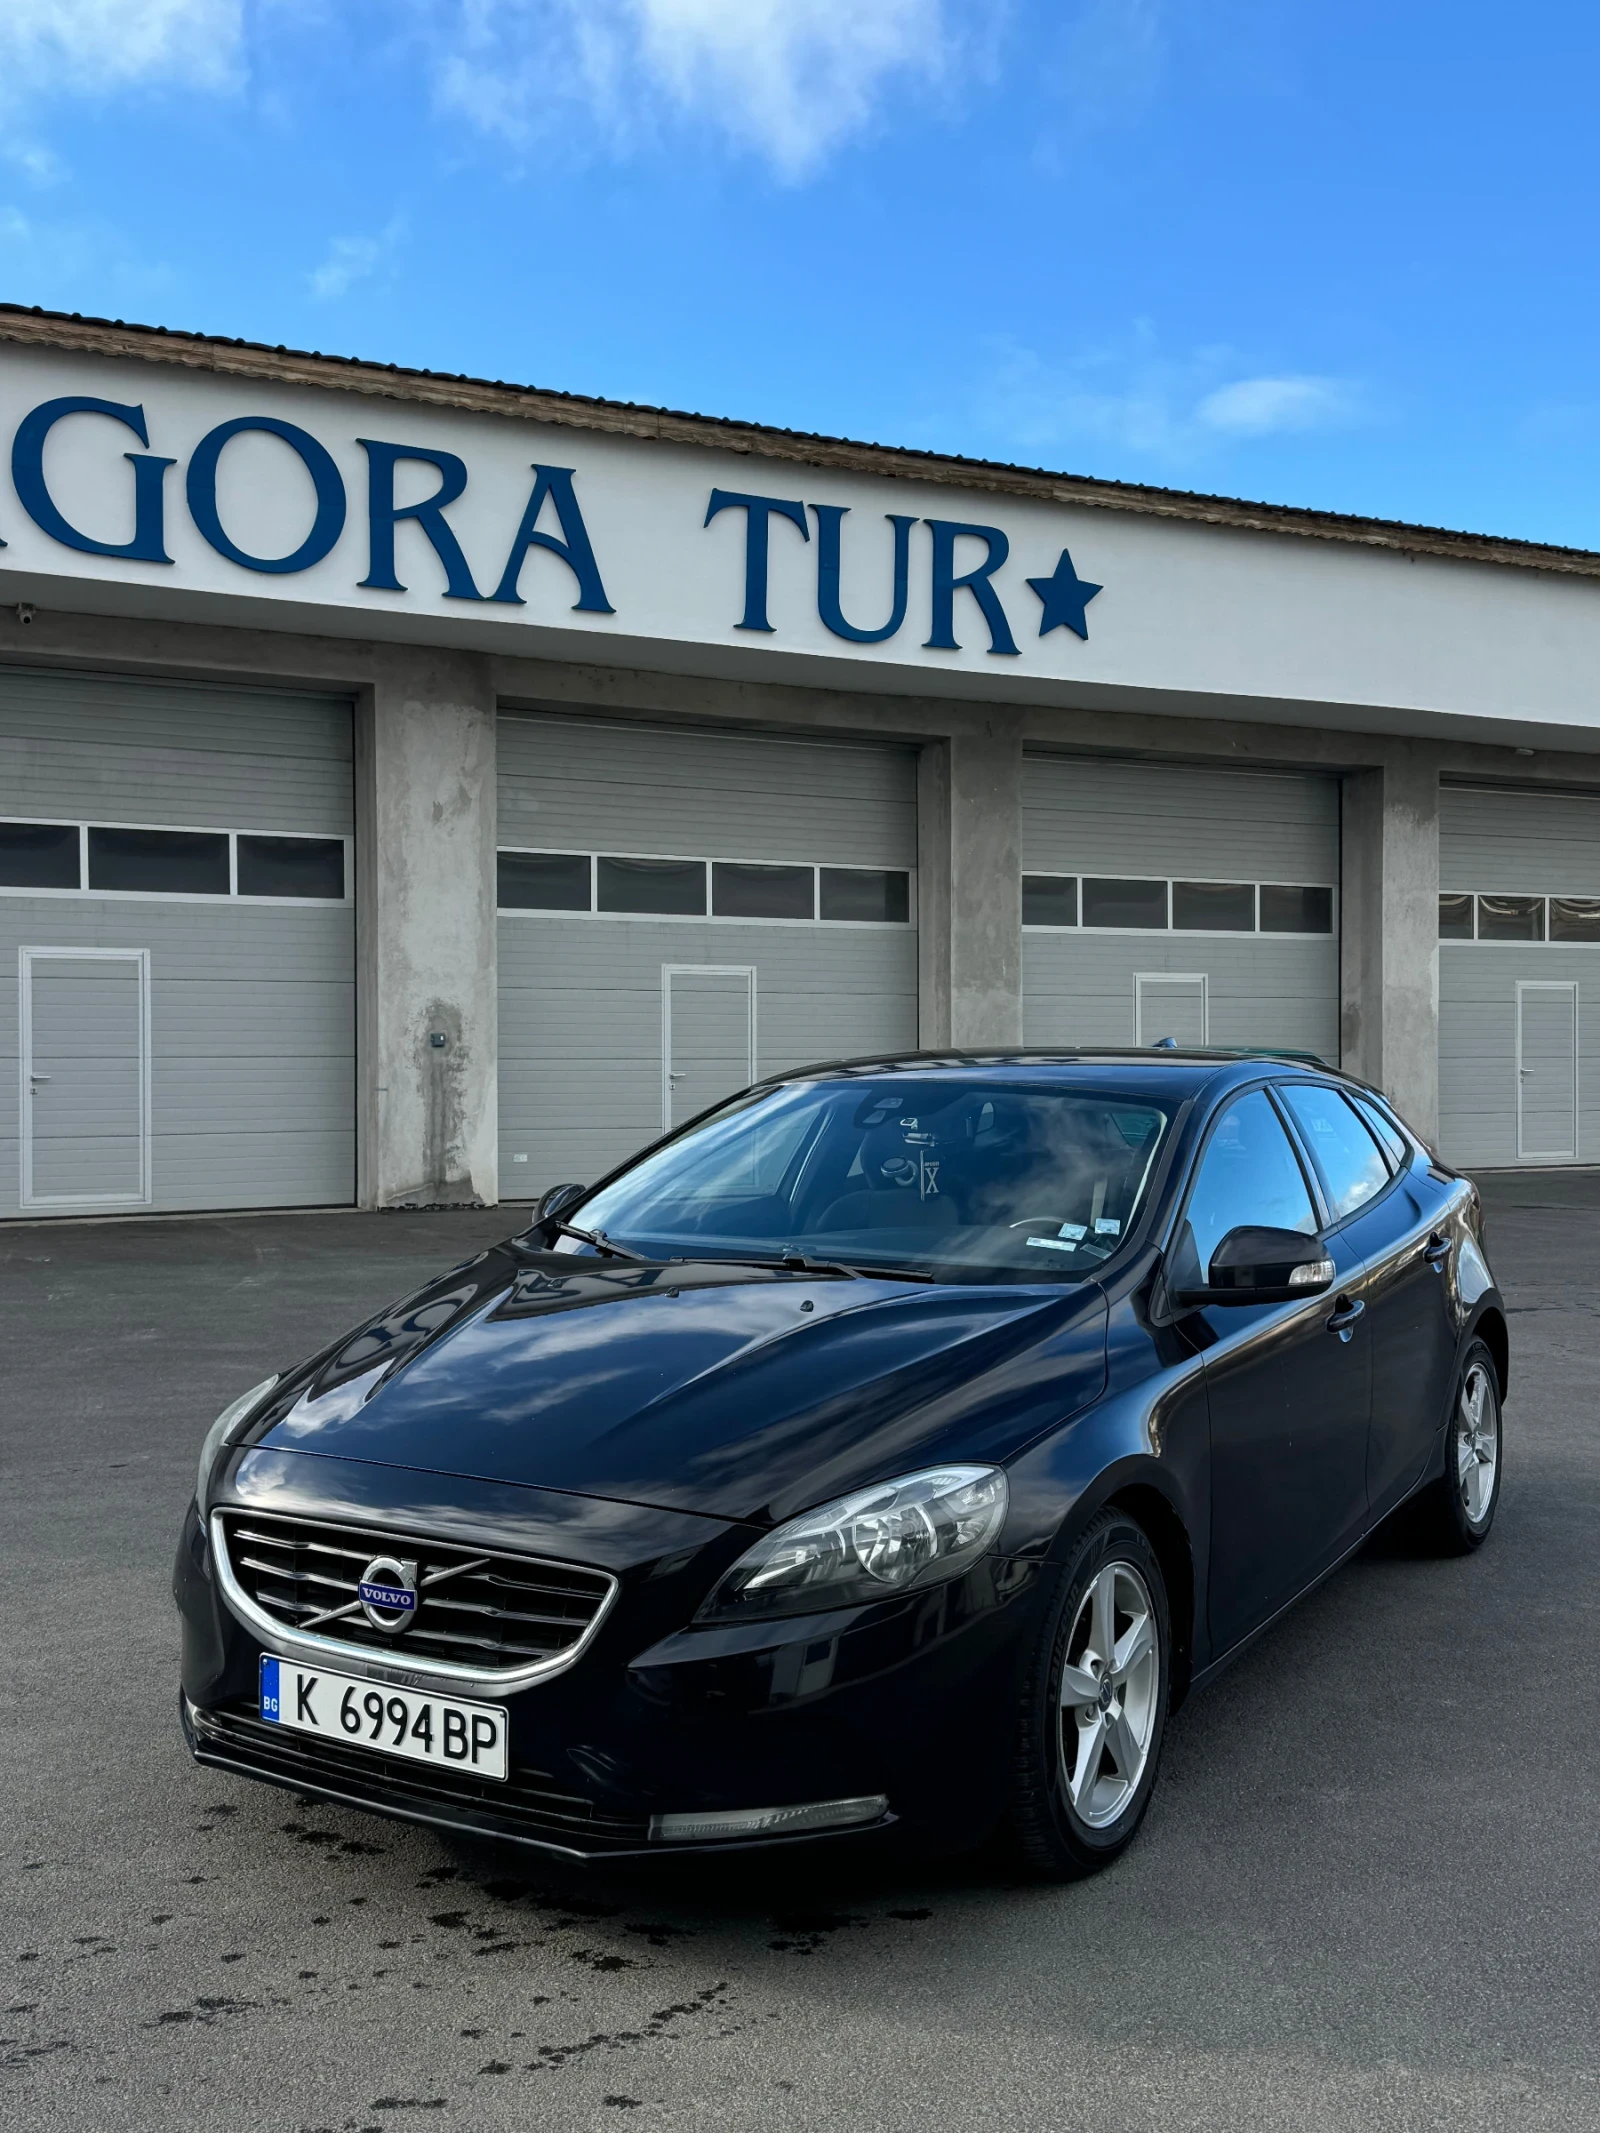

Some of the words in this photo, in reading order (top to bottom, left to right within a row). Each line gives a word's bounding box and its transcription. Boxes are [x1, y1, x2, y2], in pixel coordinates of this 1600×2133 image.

[0, 396, 617, 613] GORA
[703, 487, 1022, 655] TUR
[924, 1167, 940, 1194] X
[362, 1587, 411, 1605] VOLVO
[263, 1695, 278, 1713] BG
[297, 1673, 319, 1725] K
